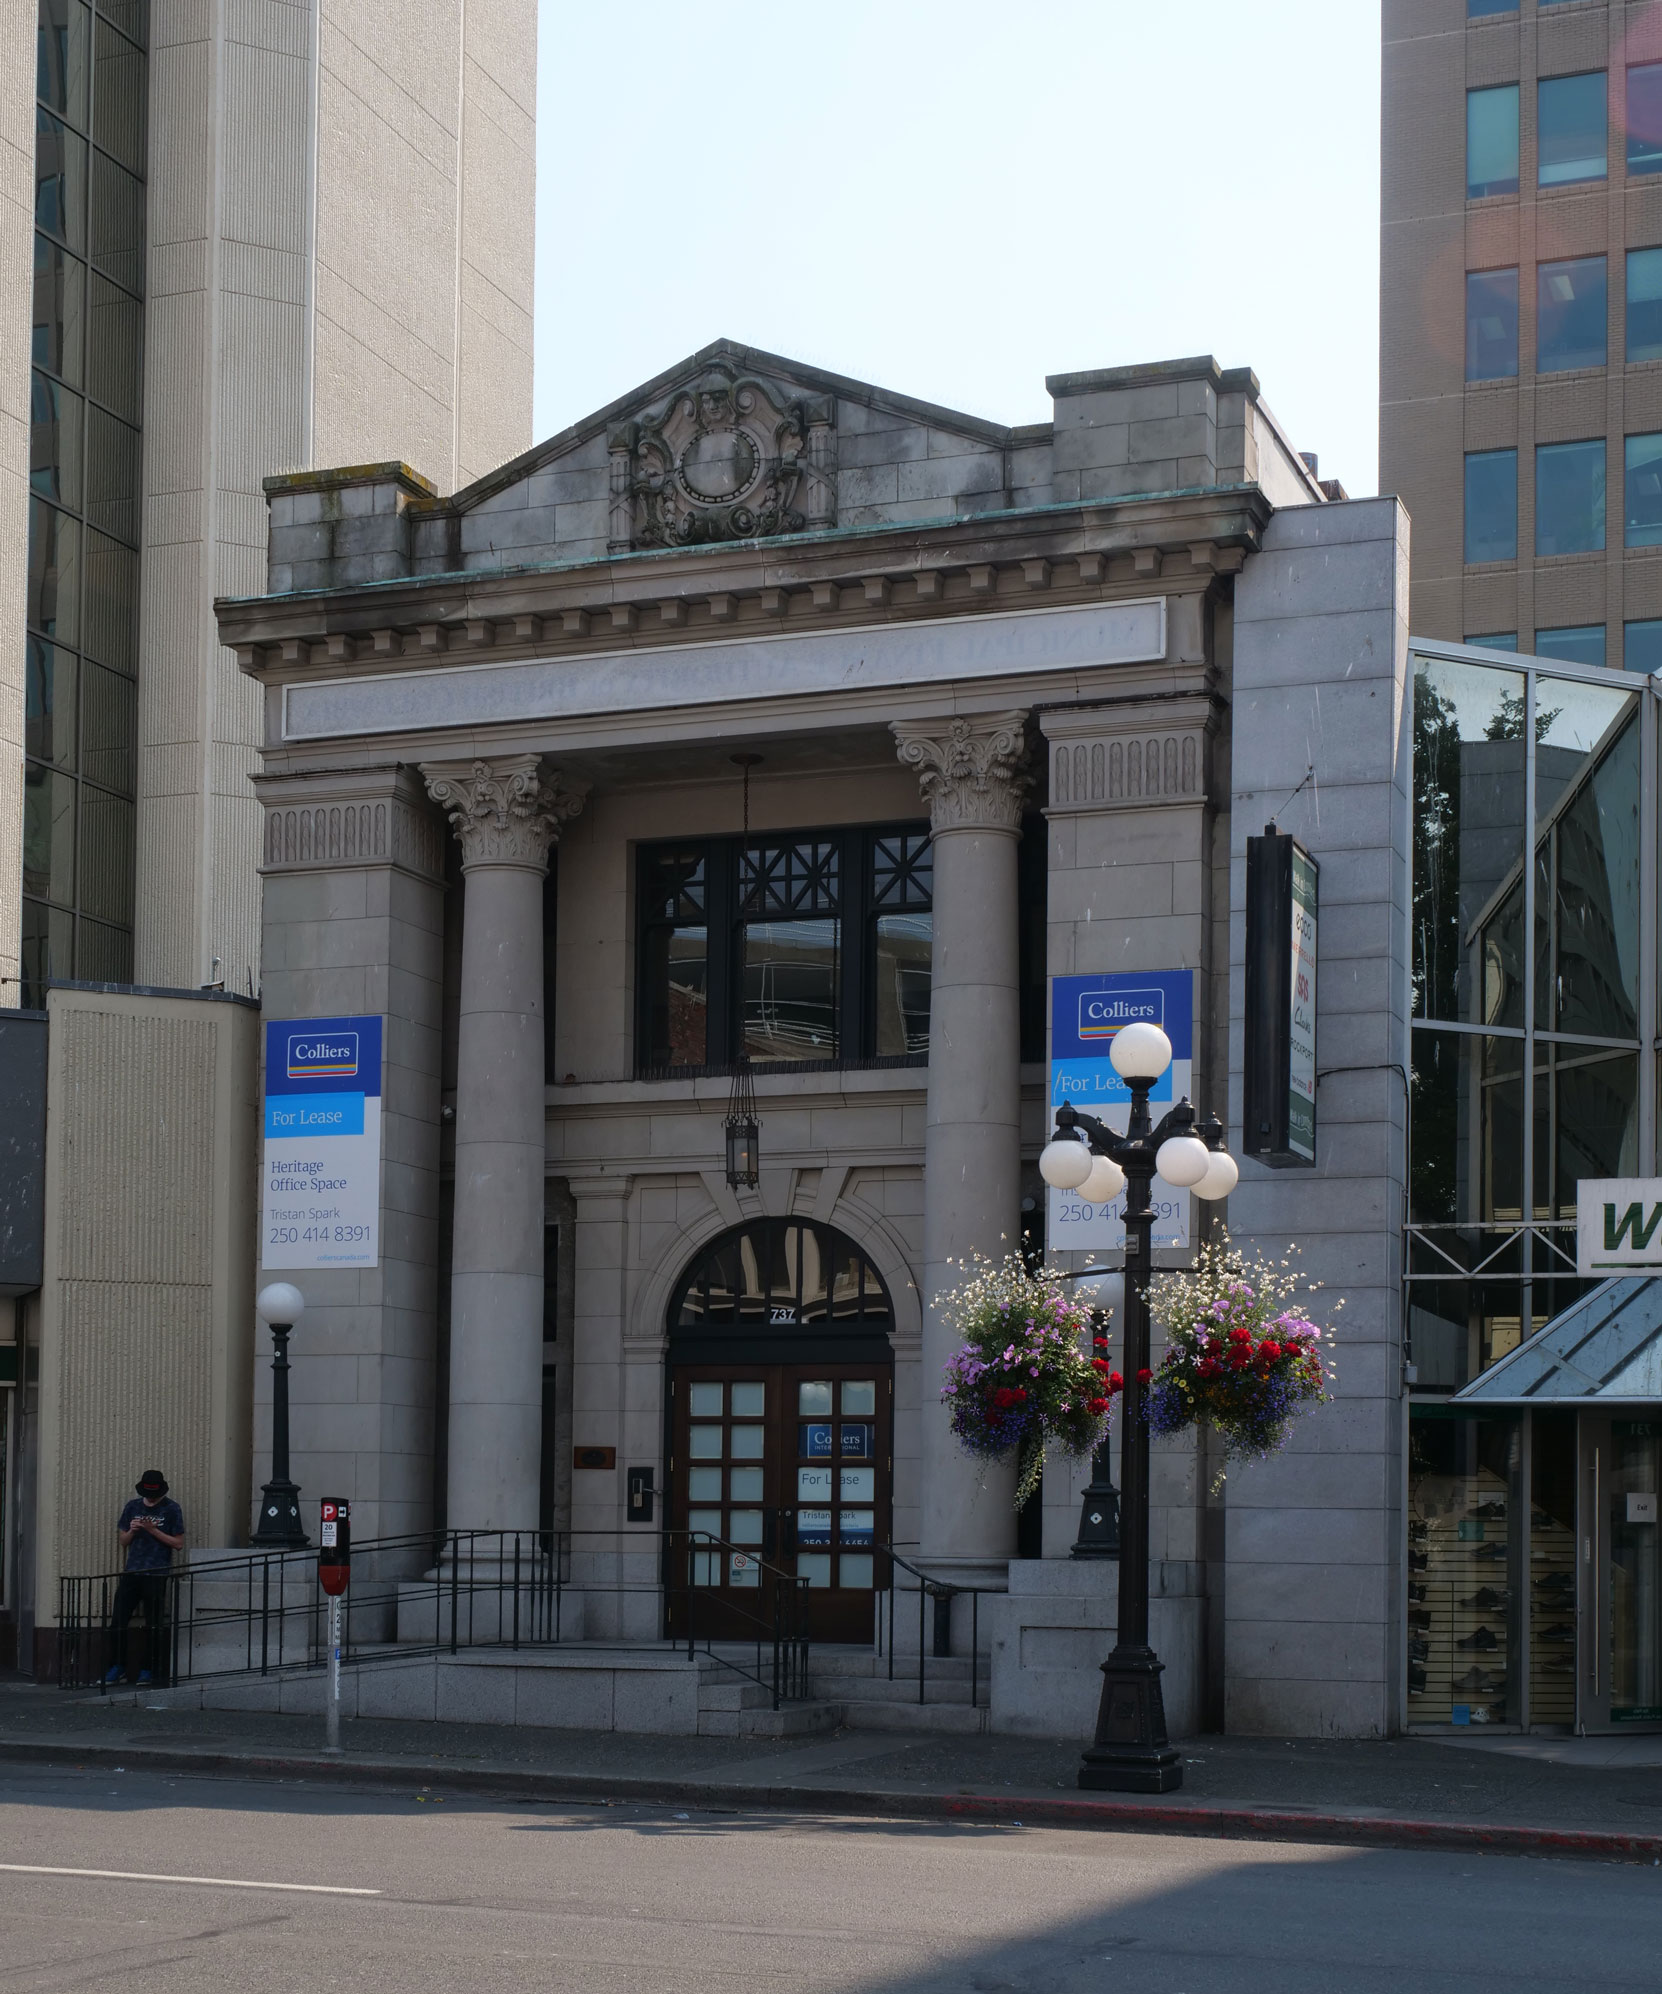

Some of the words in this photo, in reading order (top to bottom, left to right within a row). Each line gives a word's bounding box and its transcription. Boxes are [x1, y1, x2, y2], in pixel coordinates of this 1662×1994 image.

[1088, 1001, 1154, 1019] Colliers
[295, 1043, 350, 1060] Colliers
[1061, 1075, 1090, 1092] For
[1094, 1074, 1129, 1091] Lea
[272, 1111, 296, 1126] For
[299, 1108, 343, 1124] Lease
[271, 1161, 324, 1176] Heritage
[270, 1178, 306, 1192] Office
[310, 1178, 347, 1193] Space
[270, 1208, 305, 1220] Tristan
[309, 1207, 340, 1222] Spark
[1059, 1204, 1093, 1222] 250
[1150, 1202, 1180, 1220] 391
[1603, 1202, 1662, 1250] W
[270, 1227, 298, 1244] 250
[302, 1226, 329, 1242] 414
[334, 1226, 370, 1242] 8391
[771, 1308, 795, 1320] 737
[814, 1431, 860, 1444] Coiers
[802, 1473, 821, 1485] For
[826, 1473, 859, 1485] Lase
[324, 1505, 333, 1519] P
[803, 1511, 830, 1519] Tristan
